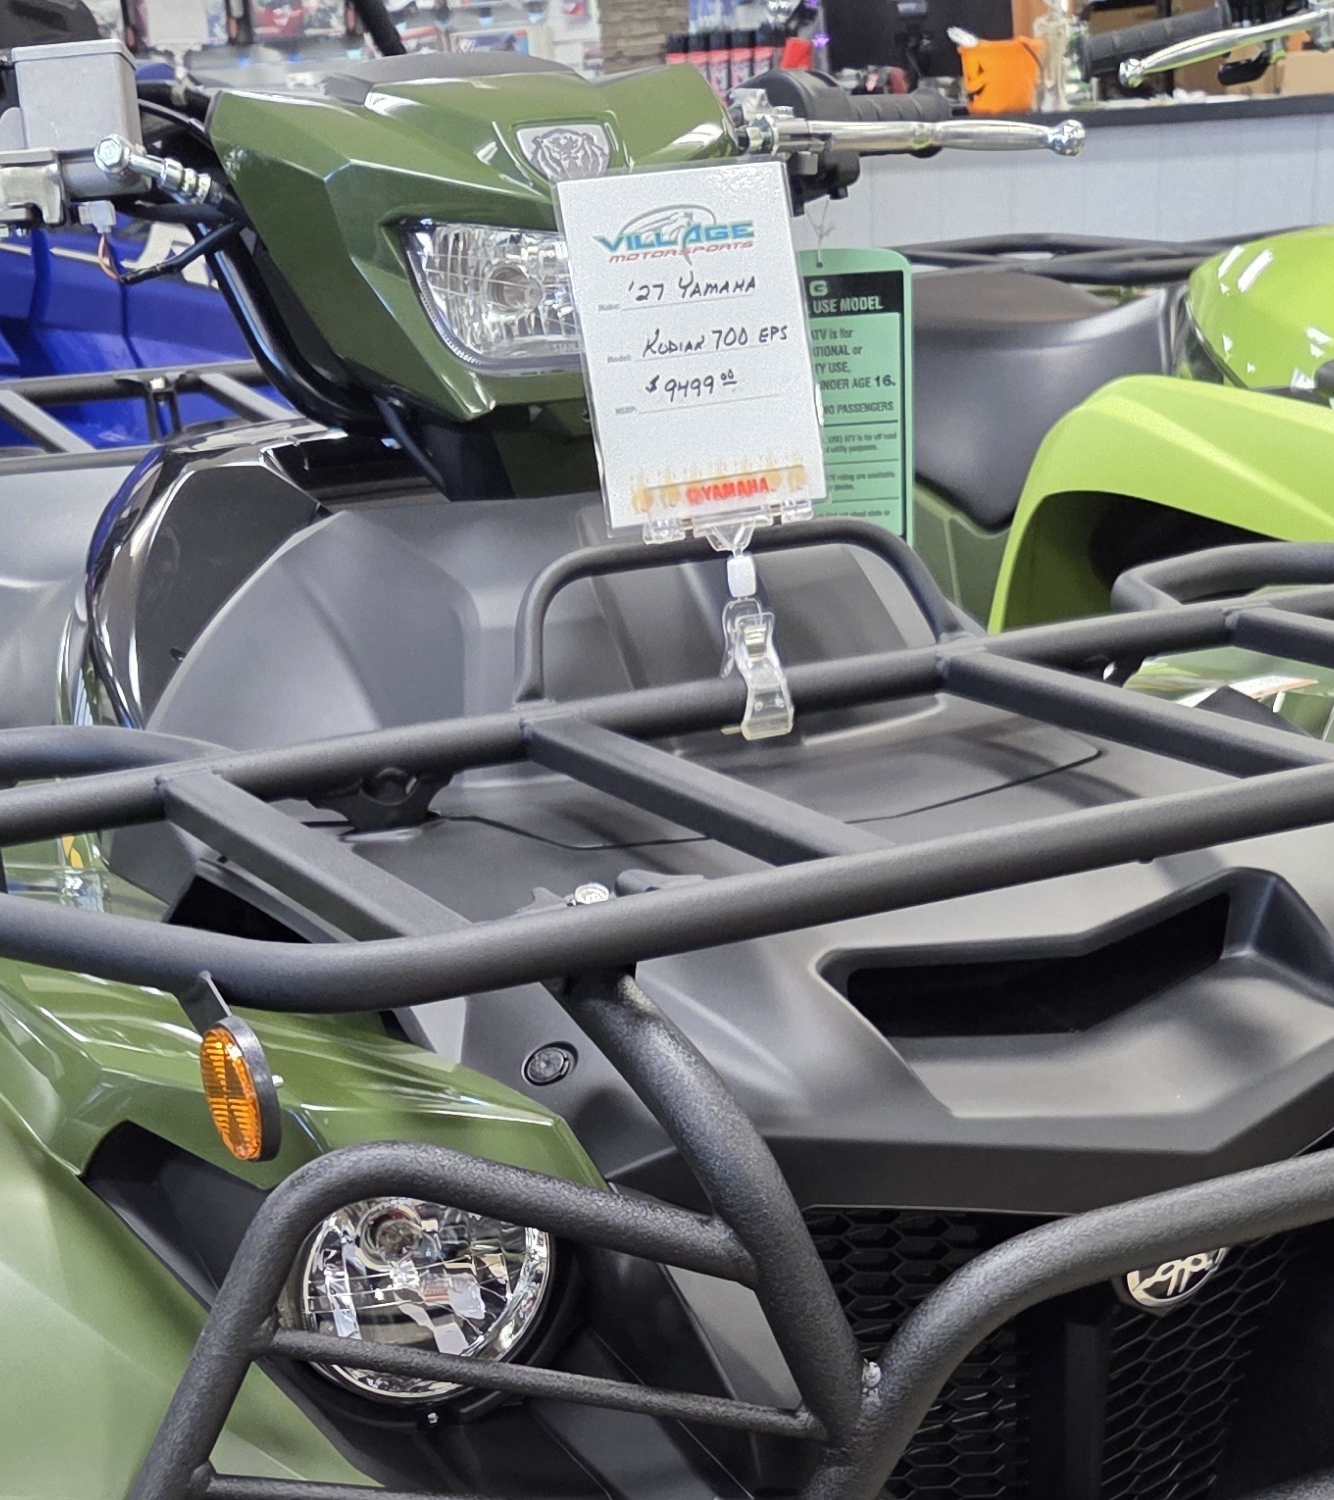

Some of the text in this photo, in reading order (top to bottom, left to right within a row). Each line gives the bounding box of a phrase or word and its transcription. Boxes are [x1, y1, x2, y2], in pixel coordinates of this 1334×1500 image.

[592, 219, 755, 253] VILLAGE
[609, 240, 755, 263] MOTORSPORTS
[678, 270, 756, 298] YAMAHA
[813, 295, 884, 313] USE MODEL
[711, 327, 748, 349] 700
[758, 325, 787, 343] EPS
[664, 375, 714, 402] 9499
[851, 377, 872, 389] AGE
[836, 401, 894, 415] PASSENGERS
[701, 477, 770, 501] YAMAHA
